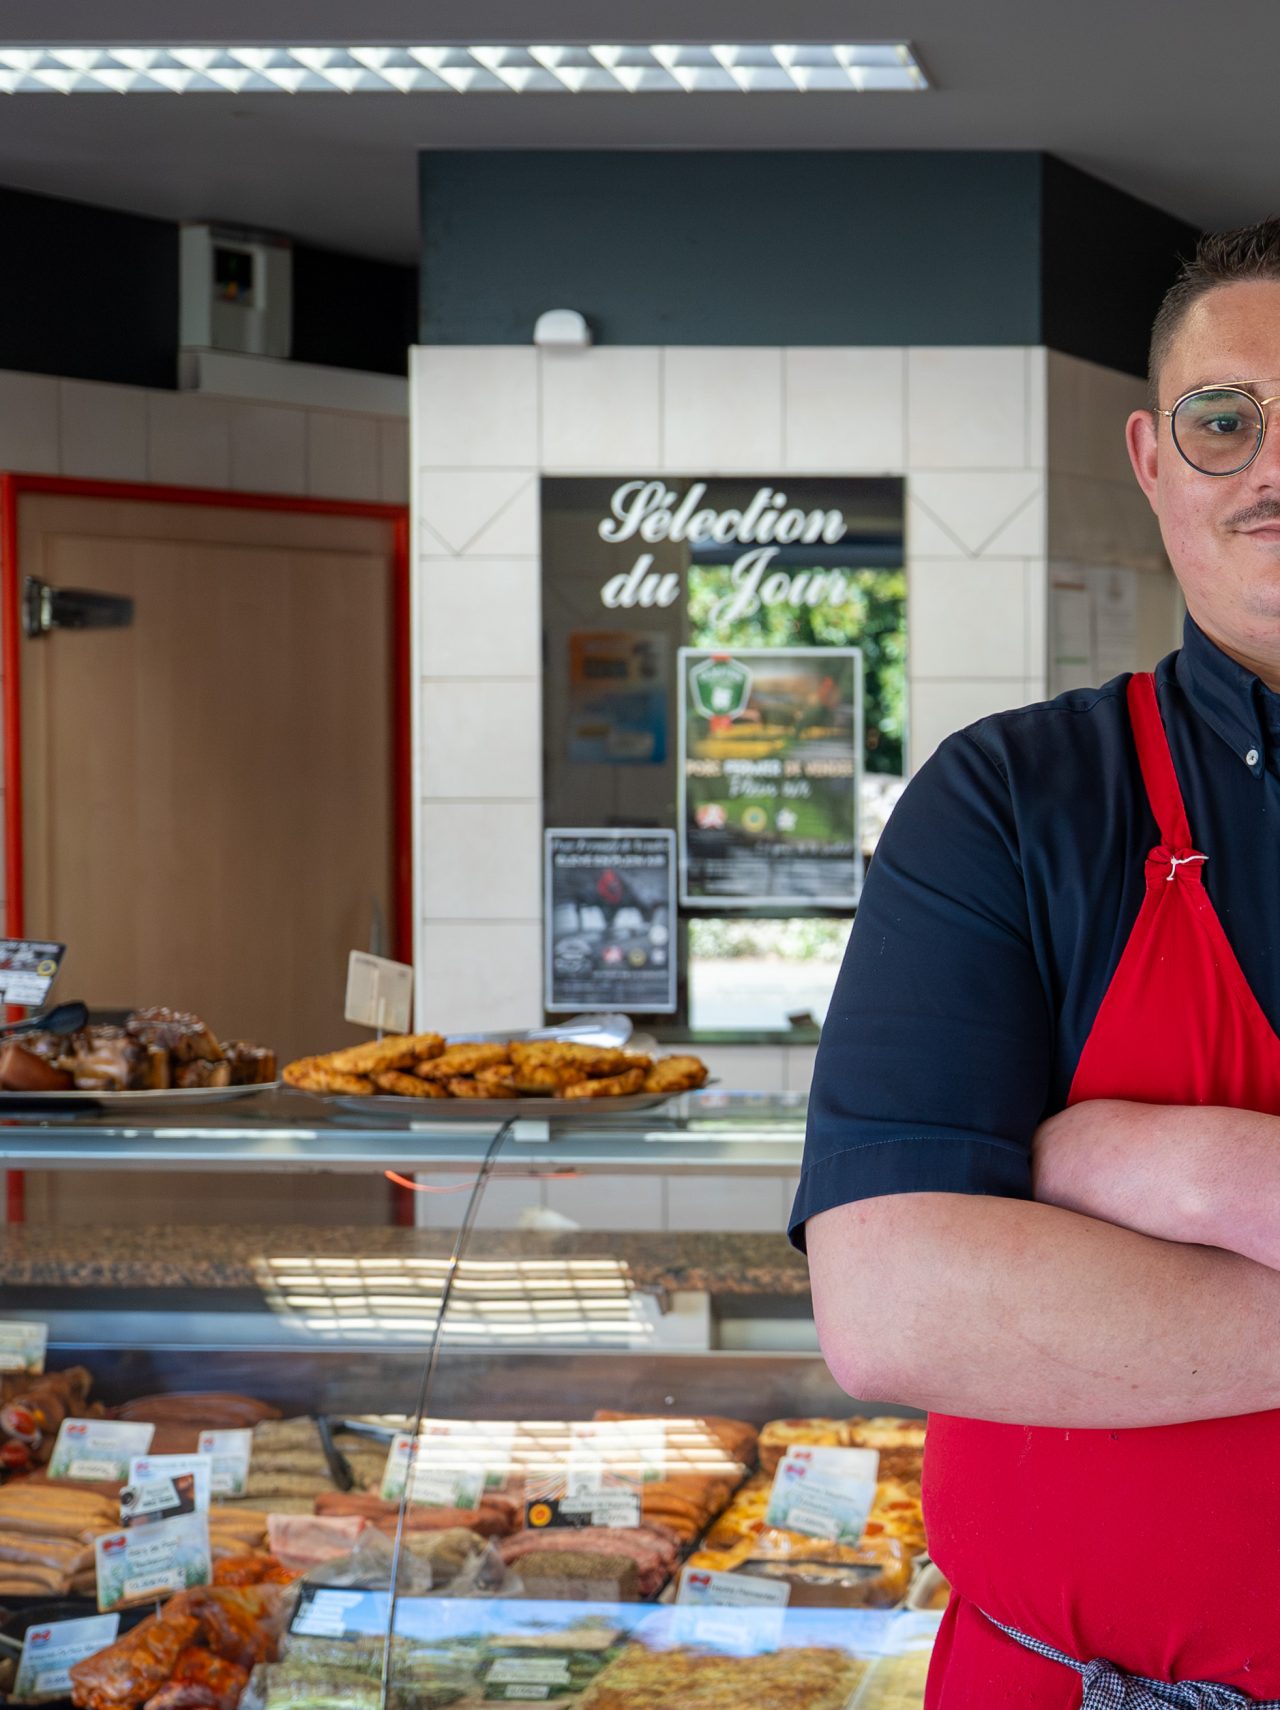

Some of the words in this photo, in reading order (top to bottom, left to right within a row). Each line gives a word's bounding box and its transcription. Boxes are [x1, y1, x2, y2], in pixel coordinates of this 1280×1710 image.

[599, 480, 847, 544] Sélection
[601, 553, 680, 608] du
[710, 546, 848, 625] Jour
